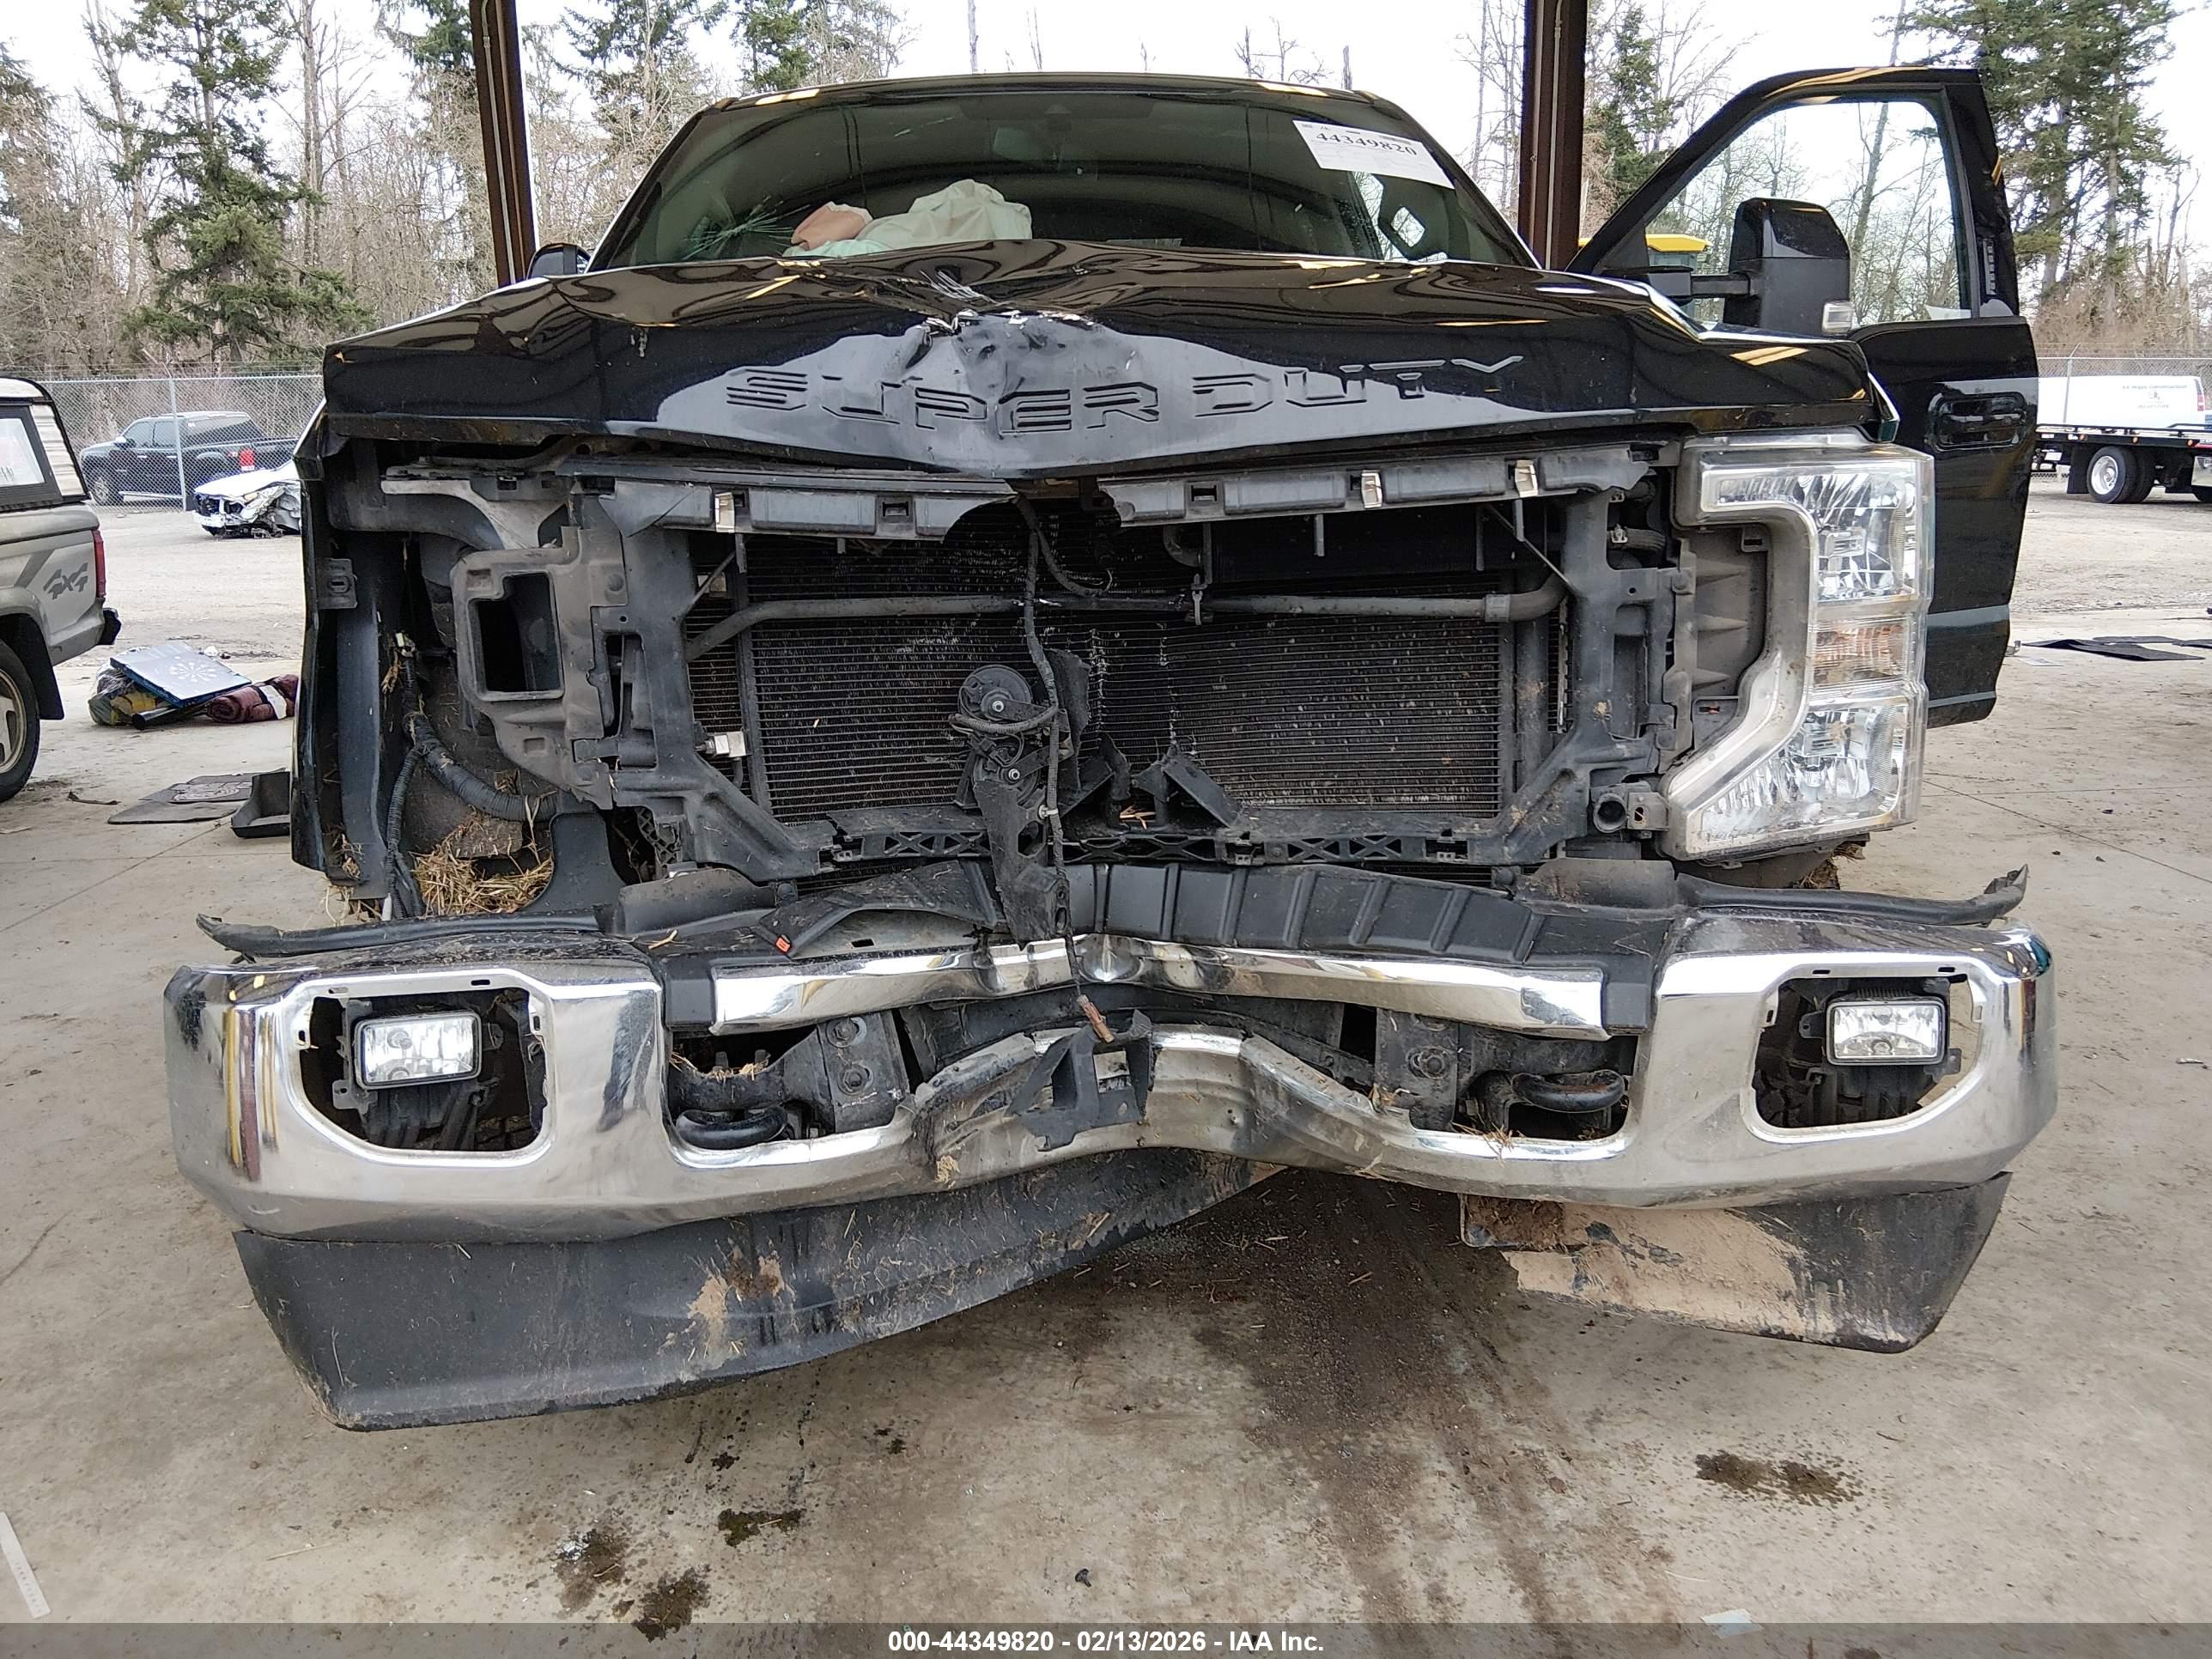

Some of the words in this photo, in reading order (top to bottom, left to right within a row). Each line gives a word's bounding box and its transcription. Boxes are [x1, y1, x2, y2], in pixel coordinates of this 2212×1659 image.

[1316, 131, 1418, 156] 44349820
[726, 368, 1159, 435] SUPER
[1192, 355, 1524, 418] DUTY
